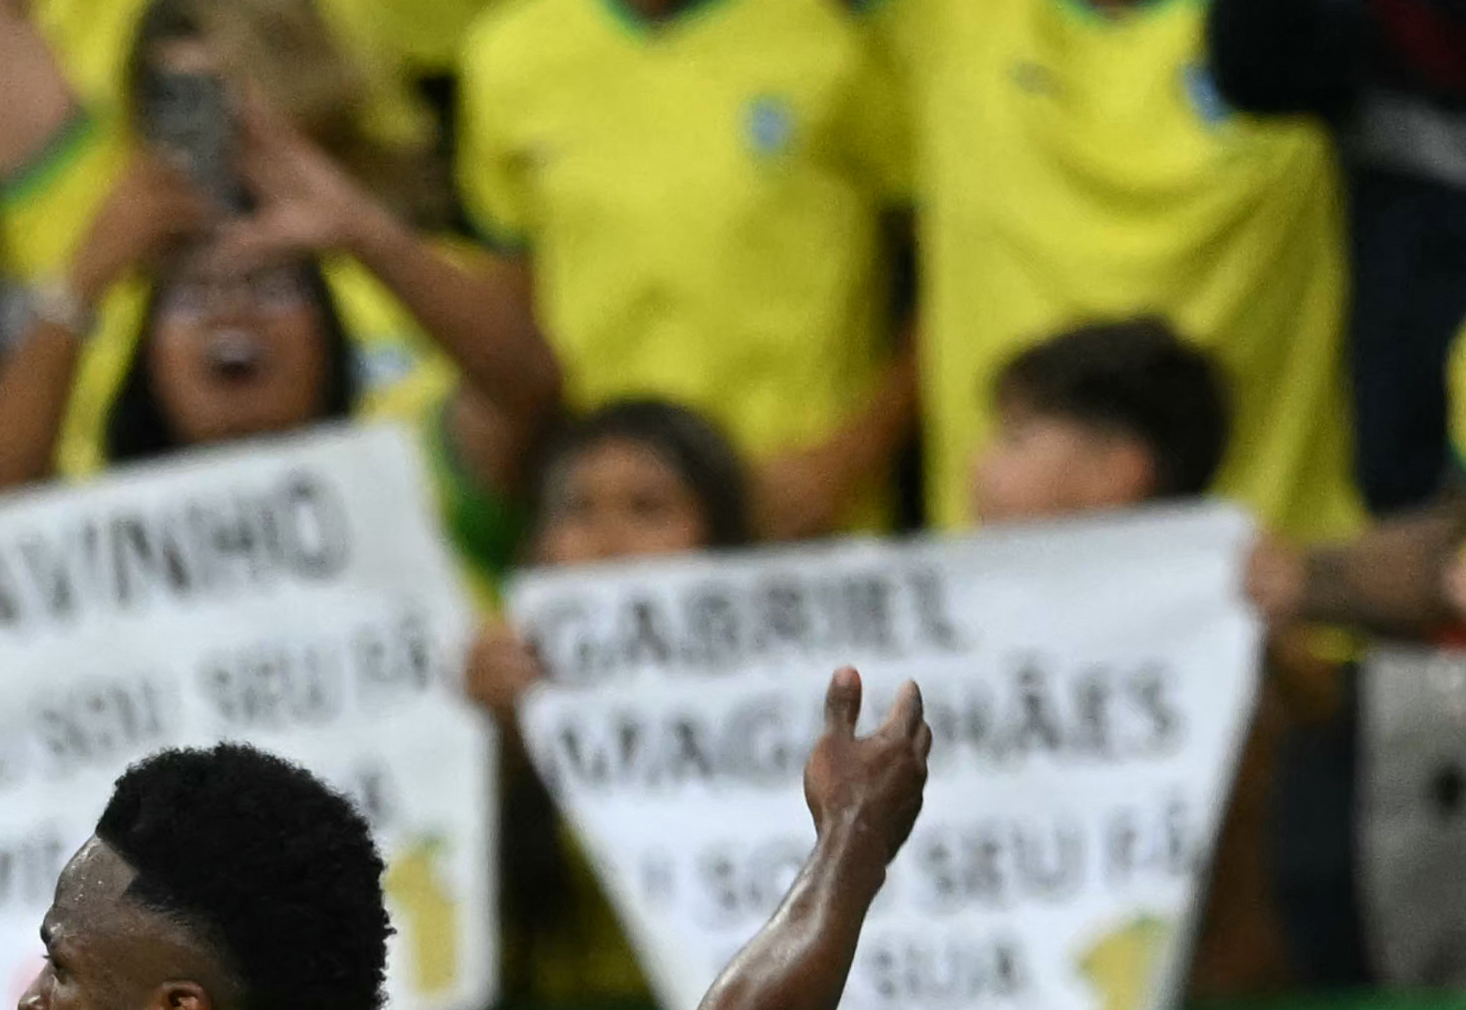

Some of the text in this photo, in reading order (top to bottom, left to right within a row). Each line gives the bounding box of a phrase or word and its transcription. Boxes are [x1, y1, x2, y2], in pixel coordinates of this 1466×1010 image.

[530, 562, 964, 680] GABRIEL
[40, 670, 170, 760] SOU
[196, 640, 340, 724] SEU
[552, 650, 1186, 786] MAGHÃES
[696, 838, 816, 928] SO
[918, 814, 1084, 904] SEU
[869, 930, 1024, 1004] SUA
